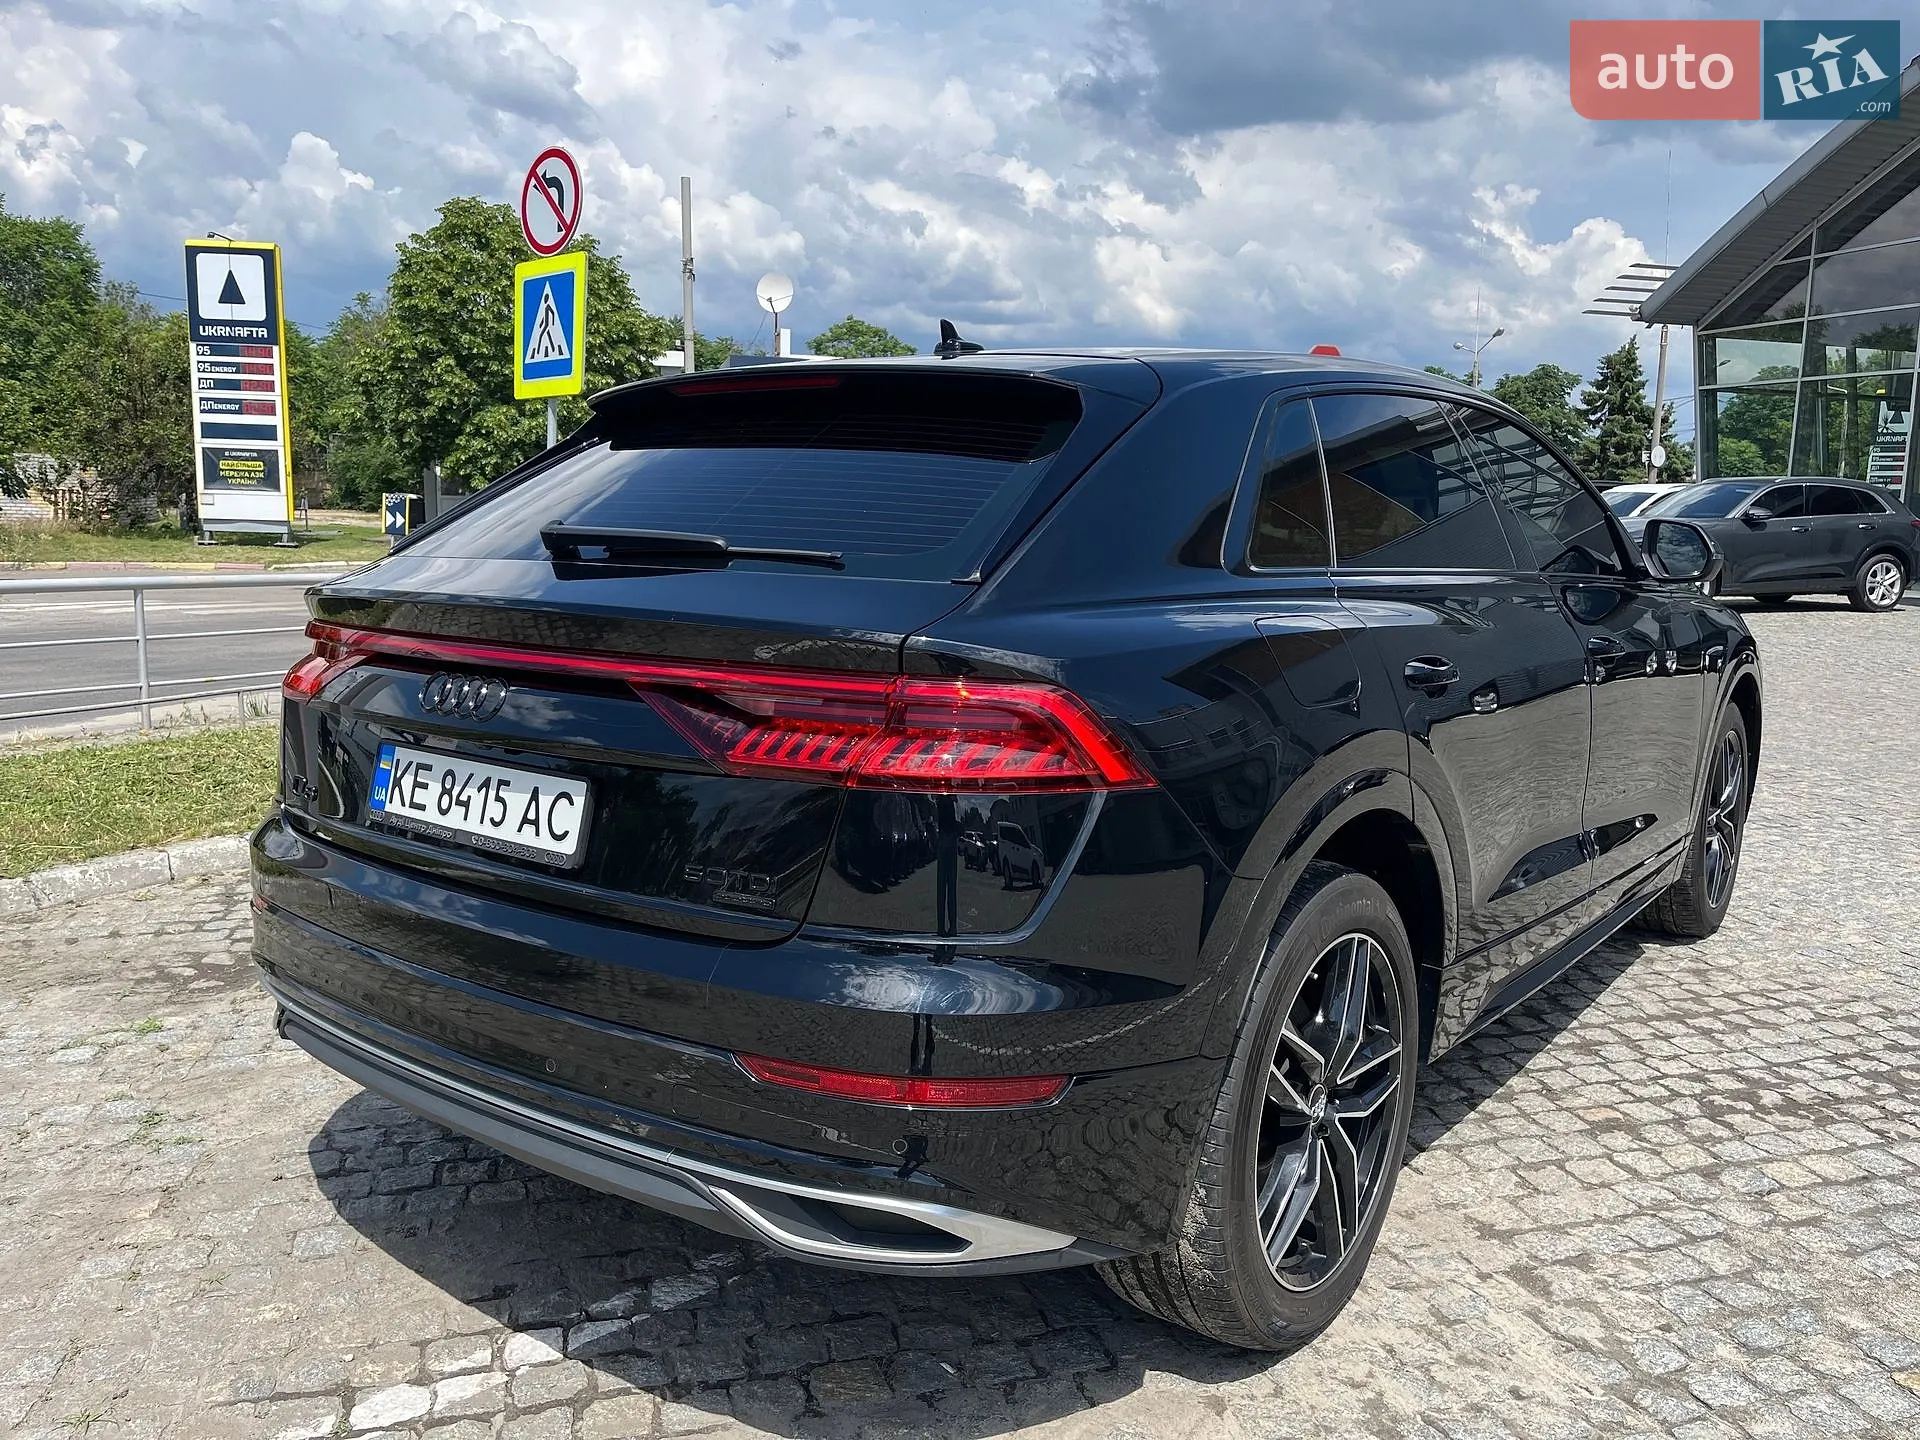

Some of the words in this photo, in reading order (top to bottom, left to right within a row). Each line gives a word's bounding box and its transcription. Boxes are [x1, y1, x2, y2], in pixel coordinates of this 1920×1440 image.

[199, 325, 268, 338] UKRNAFTA
[197, 345, 211, 355] 95
[198, 362, 211, 372] 95
[211, 365, 237, 373] ENERGY
[199, 379, 214, 389] ДП
[374, 786, 386, 802] UA
[388, 758, 433, 811] KE
[437, 768, 511, 828] 8415
[516, 785, 575, 842] AC
[405, 817, 427, 832] Центр
[426, 824, 452, 839] Дніпро
